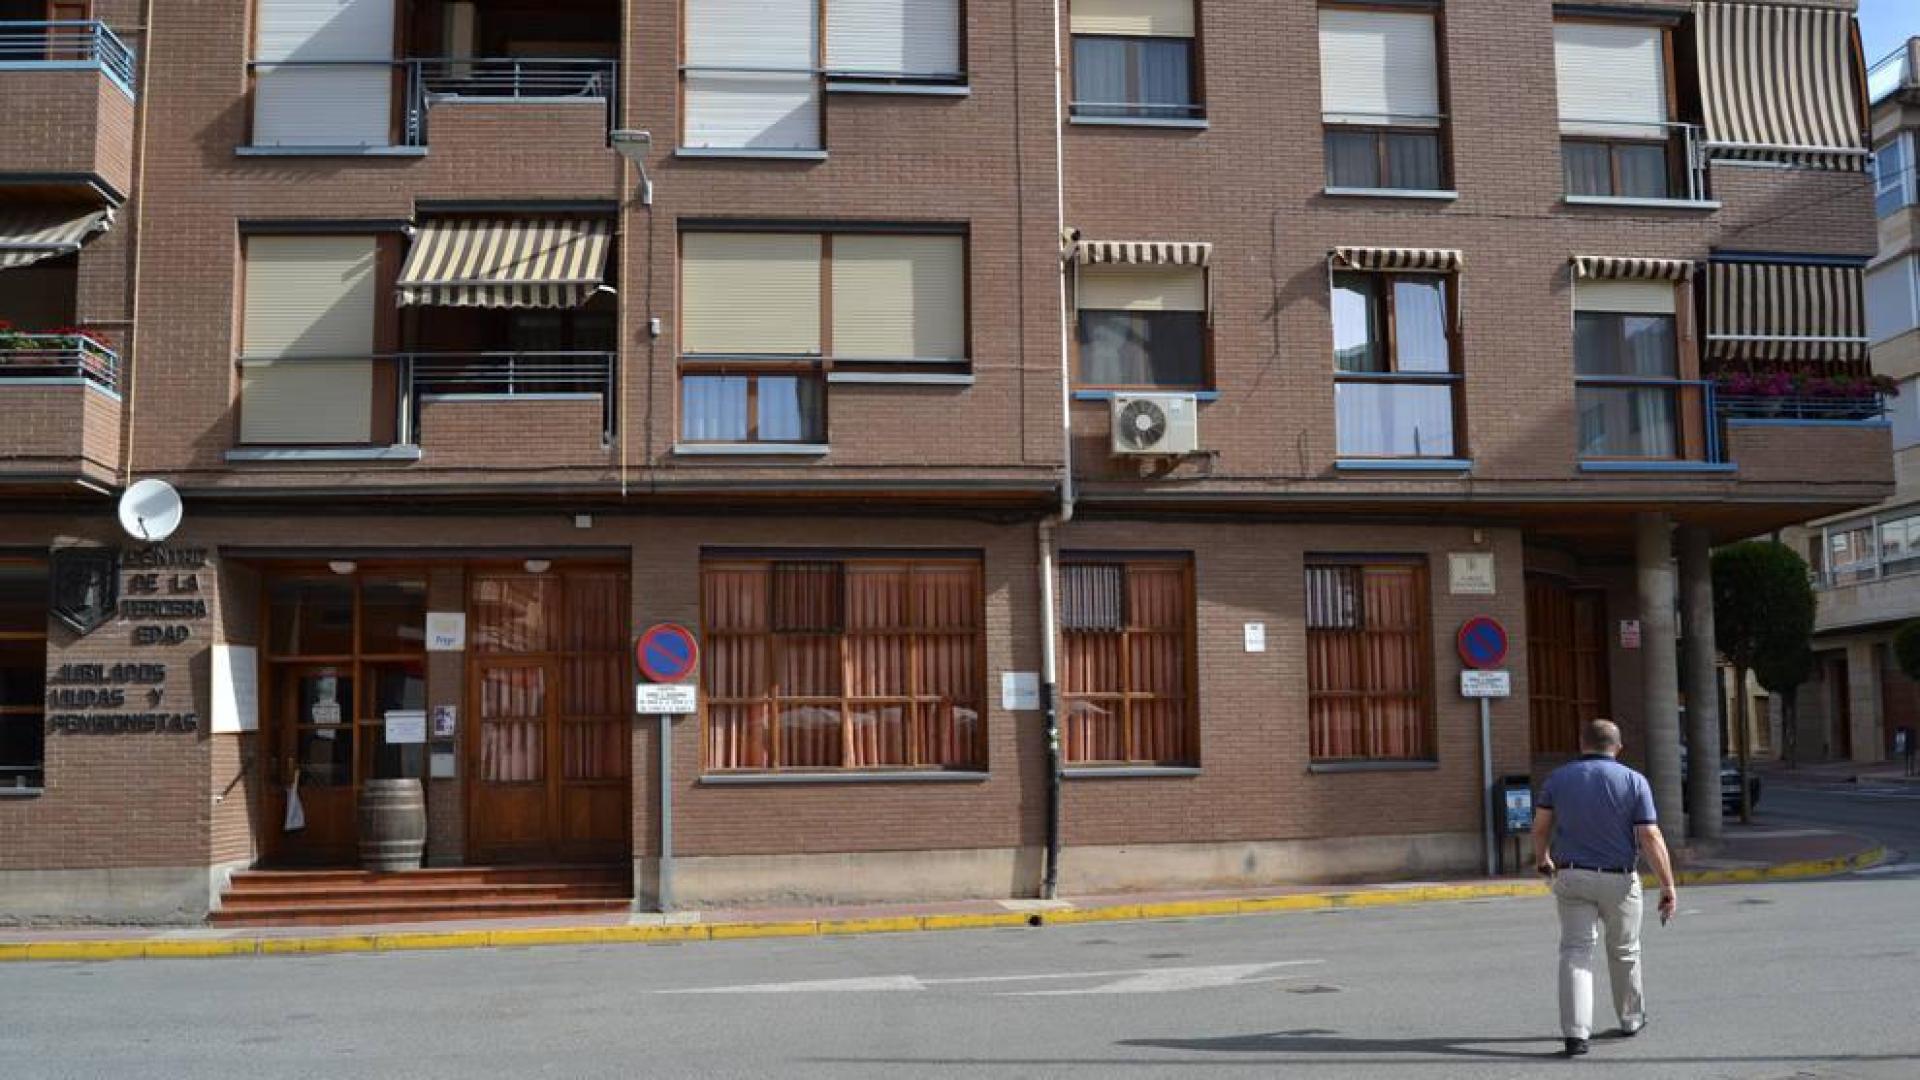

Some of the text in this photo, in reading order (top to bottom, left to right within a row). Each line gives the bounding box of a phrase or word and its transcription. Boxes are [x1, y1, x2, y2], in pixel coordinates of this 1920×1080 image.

[171, 573, 199, 592] LA
[137, 625, 190, 644] EDAD
[147, 688, 163, 705] Y
[51, 713, 198, 732] PENSIONISTAS
